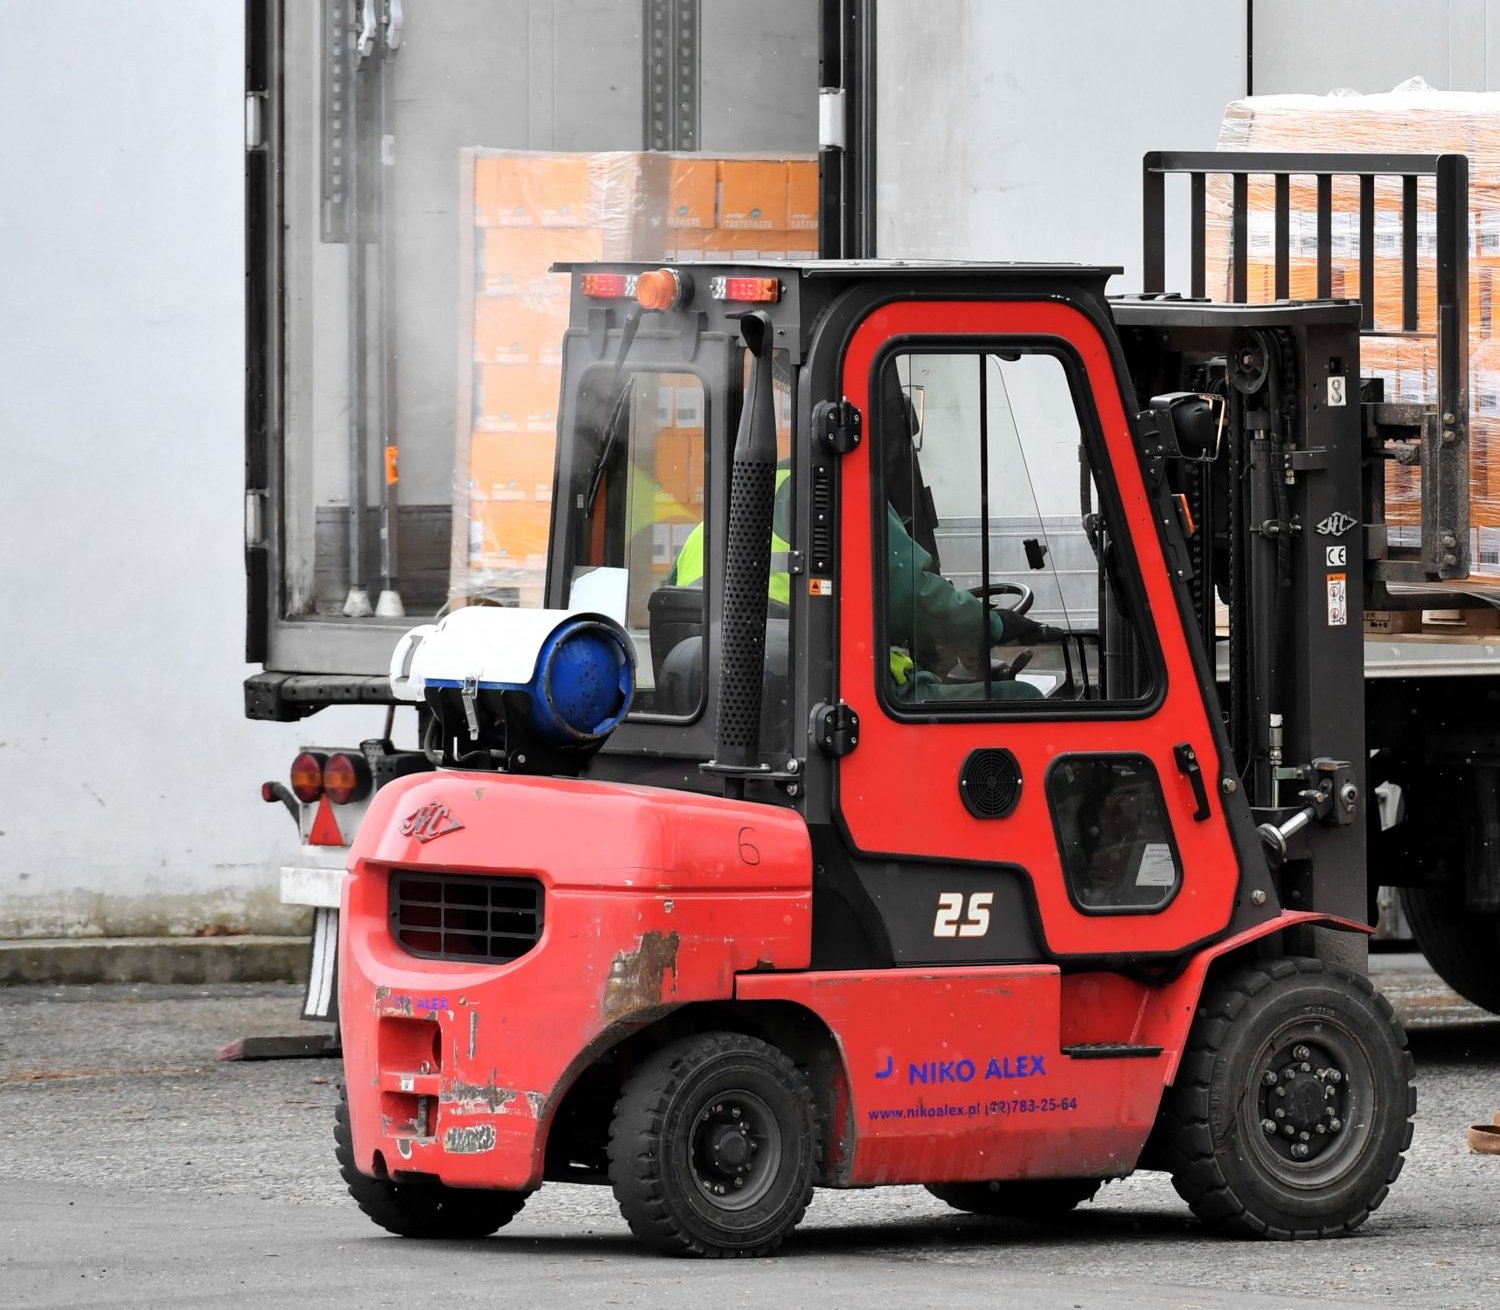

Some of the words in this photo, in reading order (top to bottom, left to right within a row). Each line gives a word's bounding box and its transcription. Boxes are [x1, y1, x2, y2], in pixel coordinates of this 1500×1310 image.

[1328, 548, 1345, 564] CE
[738, 826, 761, 866] 6
[933, 891, 994, 938] 25
[909, 1059, 975, 1085] NIKO
[984, 1055, 1047, 1080] ALEX
[868, 1102, 980, 1120] www.nikoalex.pl
